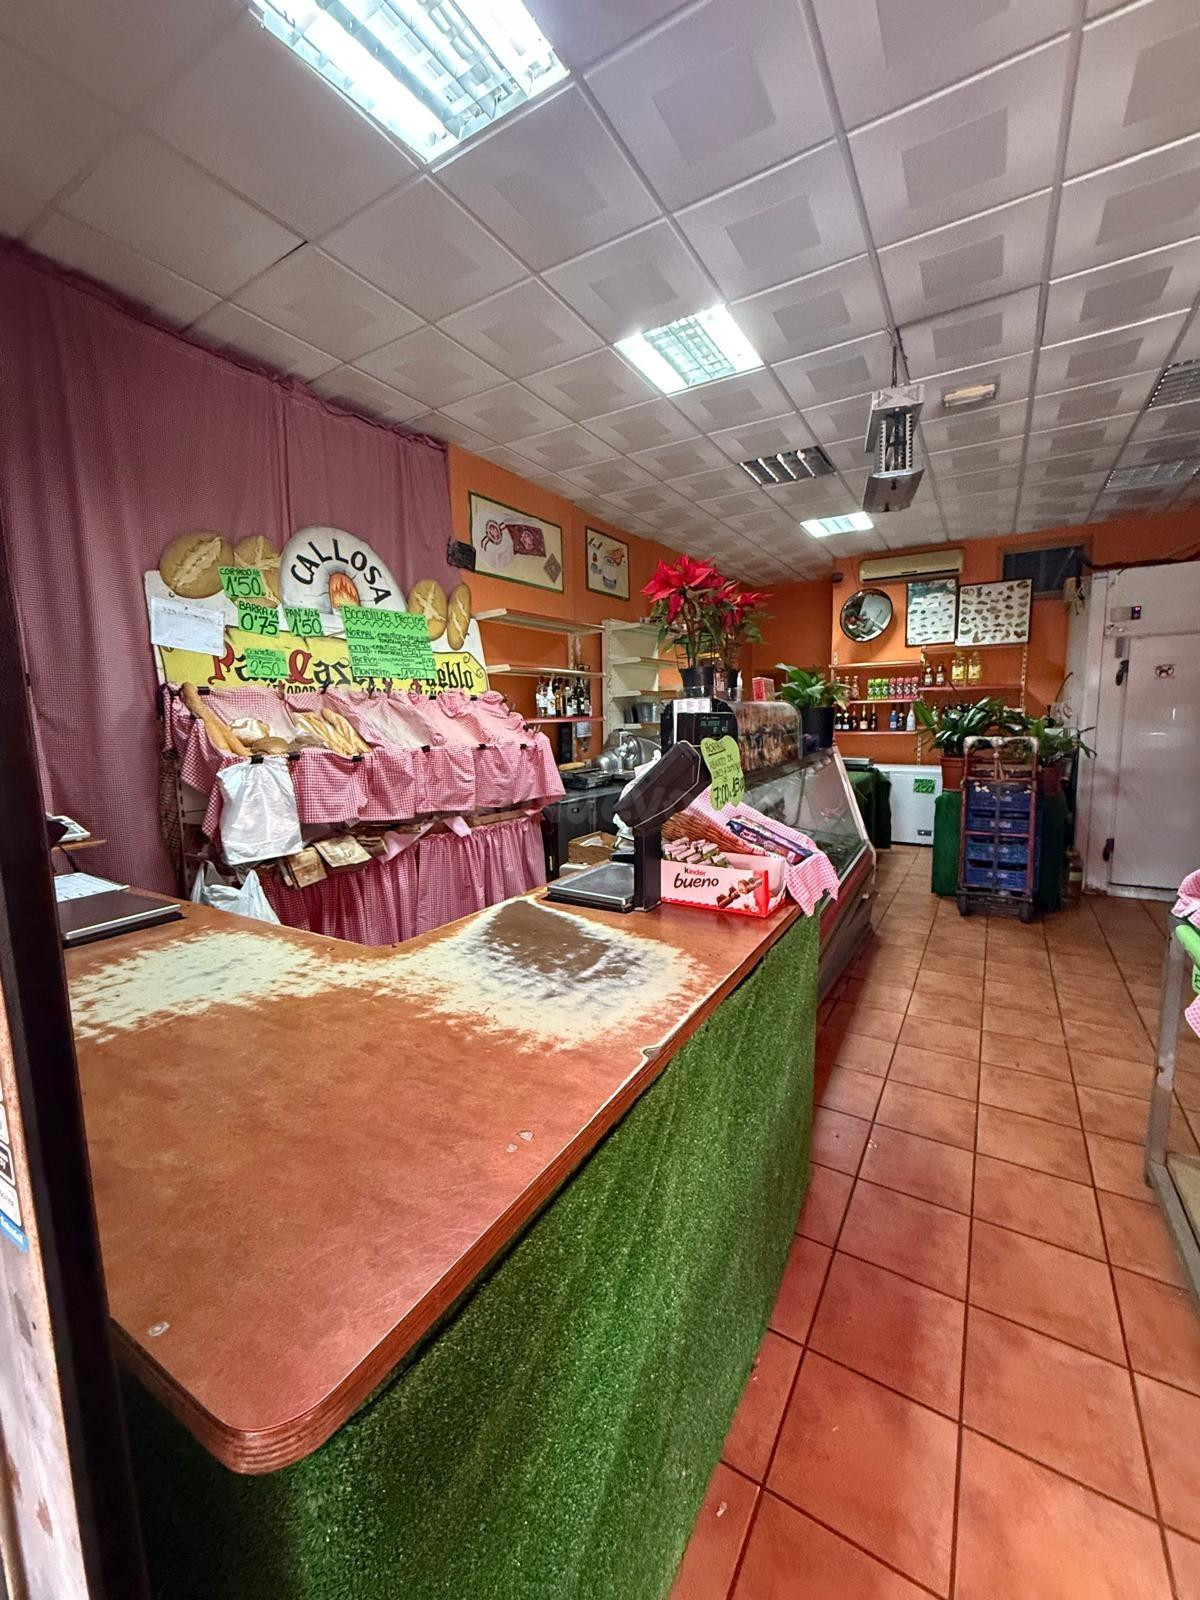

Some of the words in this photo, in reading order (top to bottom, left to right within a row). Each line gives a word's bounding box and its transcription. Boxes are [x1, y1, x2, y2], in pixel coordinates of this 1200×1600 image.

[290, 538, 392, 605] CALLOSA
[238, 601, 269, 616] BARRA
[240, 612, 280, 635] 0'75
[684, 867, 706, 876] kinder
[673, 872, 719, 889] bueno
